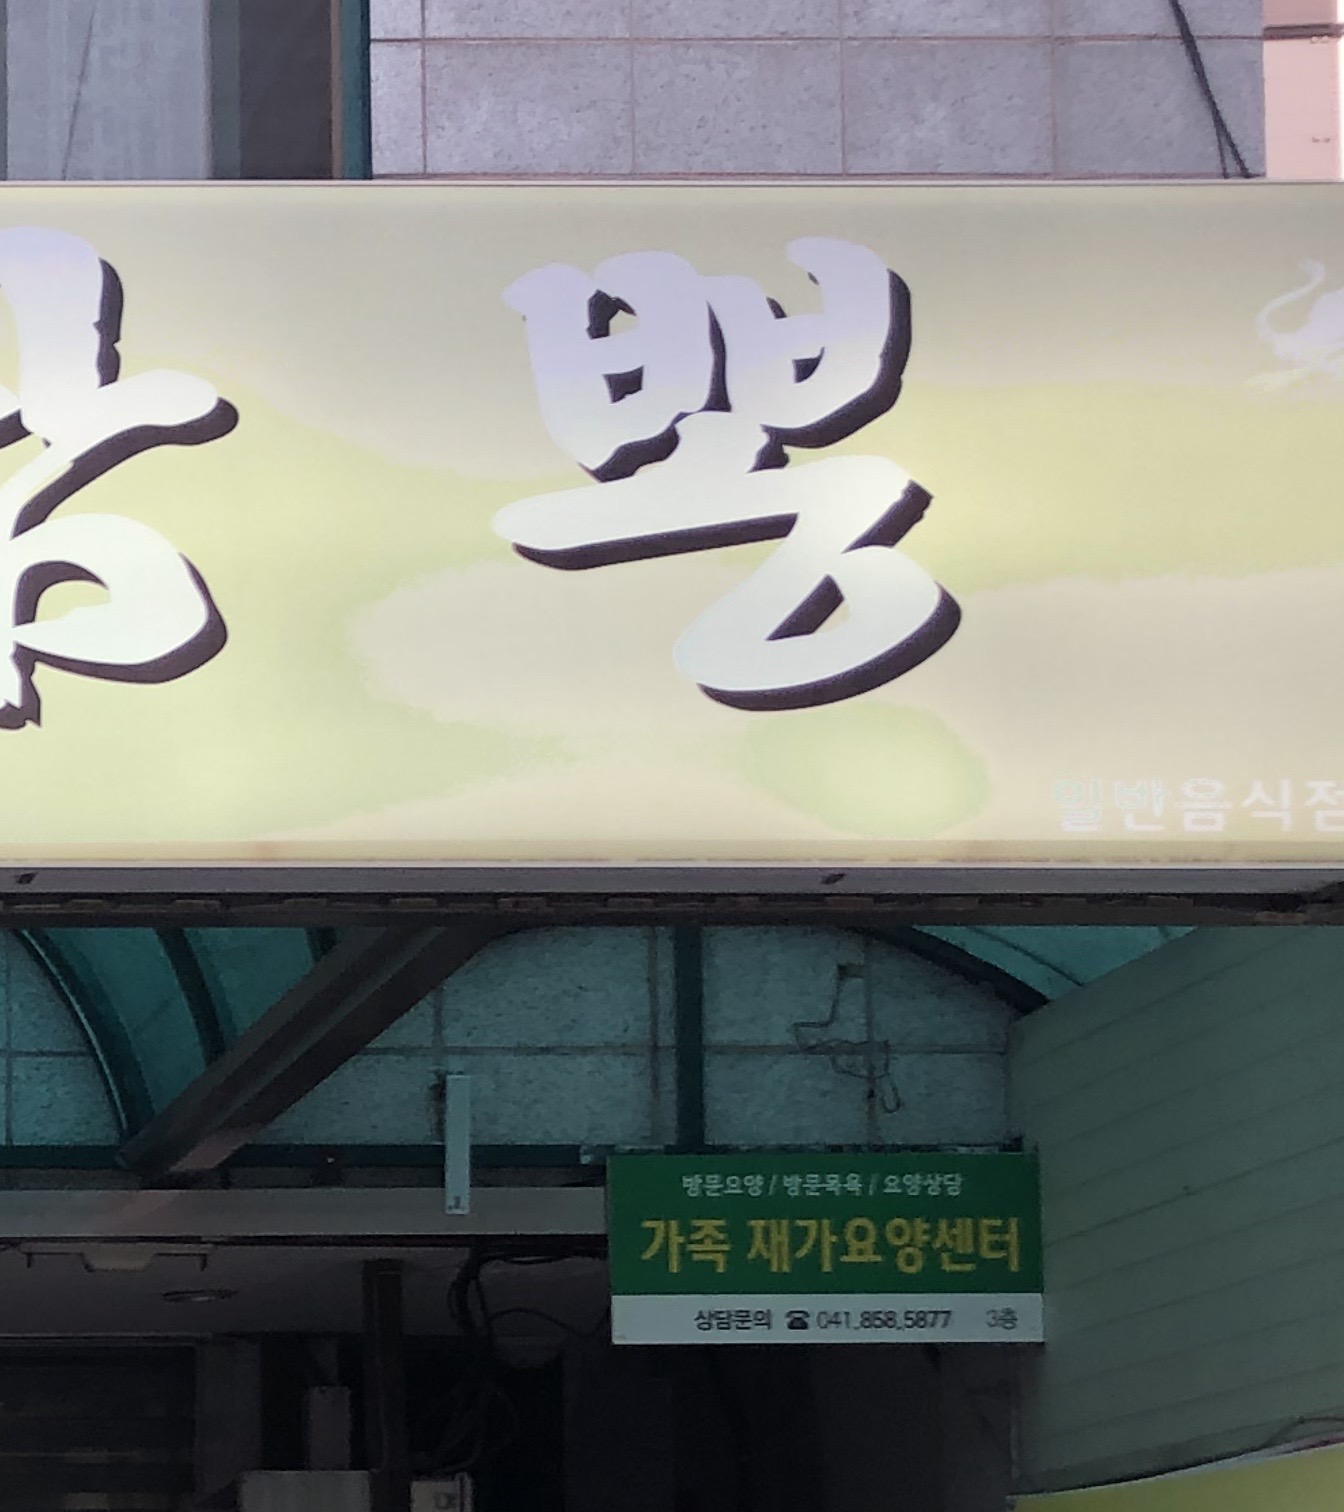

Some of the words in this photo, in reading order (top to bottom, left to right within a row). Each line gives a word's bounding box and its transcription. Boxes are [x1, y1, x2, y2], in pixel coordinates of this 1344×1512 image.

[682, 1173, 764, 1197] 방문요양
[782, 1173, 863, 1196] 방문목욕
[883, 1172, 964, 1196] 요양상담
[640, 1216, 730, 1274] 가족
[747, 1216, 1021, 1274] 재가요양센터
[694, 1308, 772, 1331] 상담문의
[986, 1308, 1018, 1331] 3층
